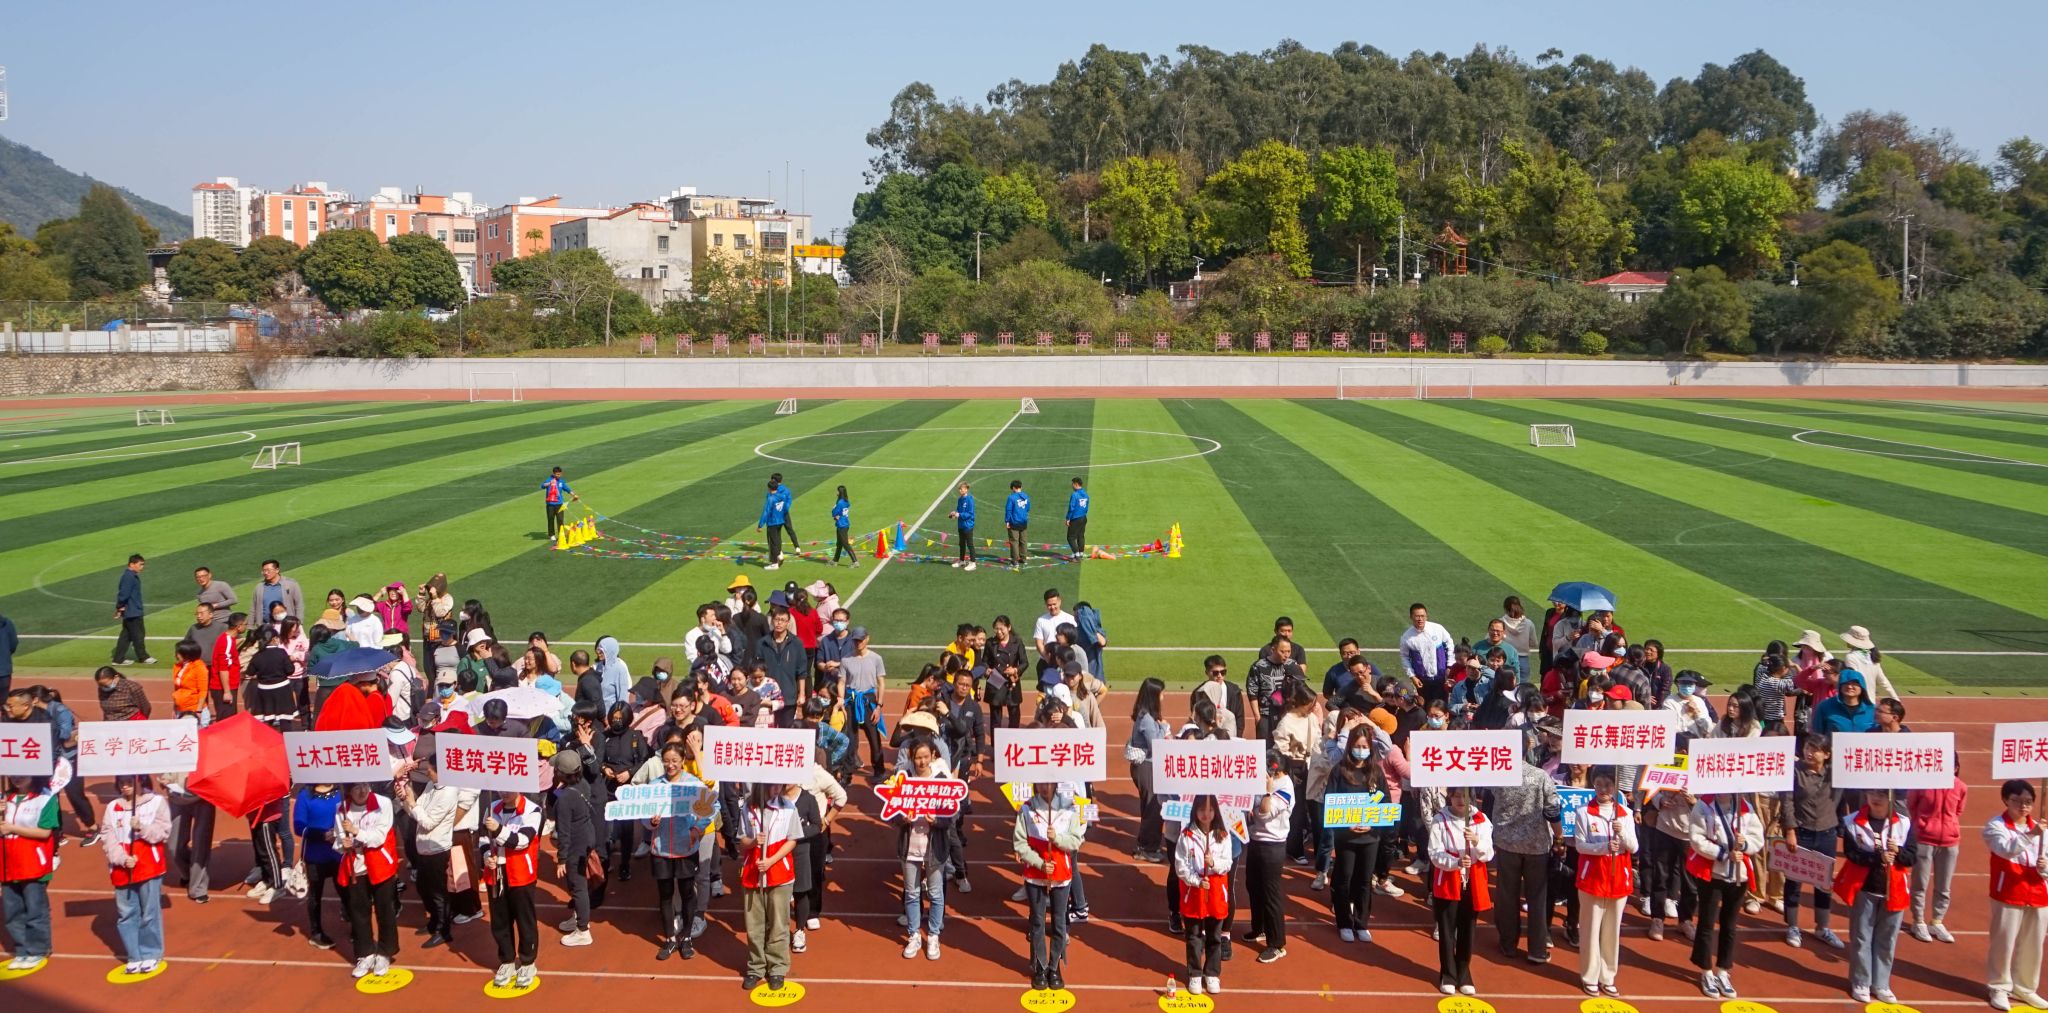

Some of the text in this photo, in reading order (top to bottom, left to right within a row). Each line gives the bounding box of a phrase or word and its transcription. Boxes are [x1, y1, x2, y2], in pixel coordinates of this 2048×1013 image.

[0, 737, 41, 760] 工会
[80, 733, 198, 757] 医学院工会
[1573, 724, 1666, 750] 音乐舞蹈学院
[296, 743, 381, 769] 土木工程学院
[446, 747, 529, 777] 建筑学院
[714, 741, 805, 768] 信息科学与工程学院
[1004, 742, 1095, 768] 化工学院
[1421, 746, 1513, 772] 华文学院
[1843, 748, 1944, 772] 计算机科学与技术学院
[2001, 738, 2048, 763] 国际关
[1164, 755, 1258, 780] 机电及自动化学院
[1696, 752, 1785, 777] 材料科学与工程学院
[889, 796, 955, 810] 争优又创先
[901, 784, 964, 797] 伟大半边天
[1326, 806, 1399, 824] 映耀芳华
